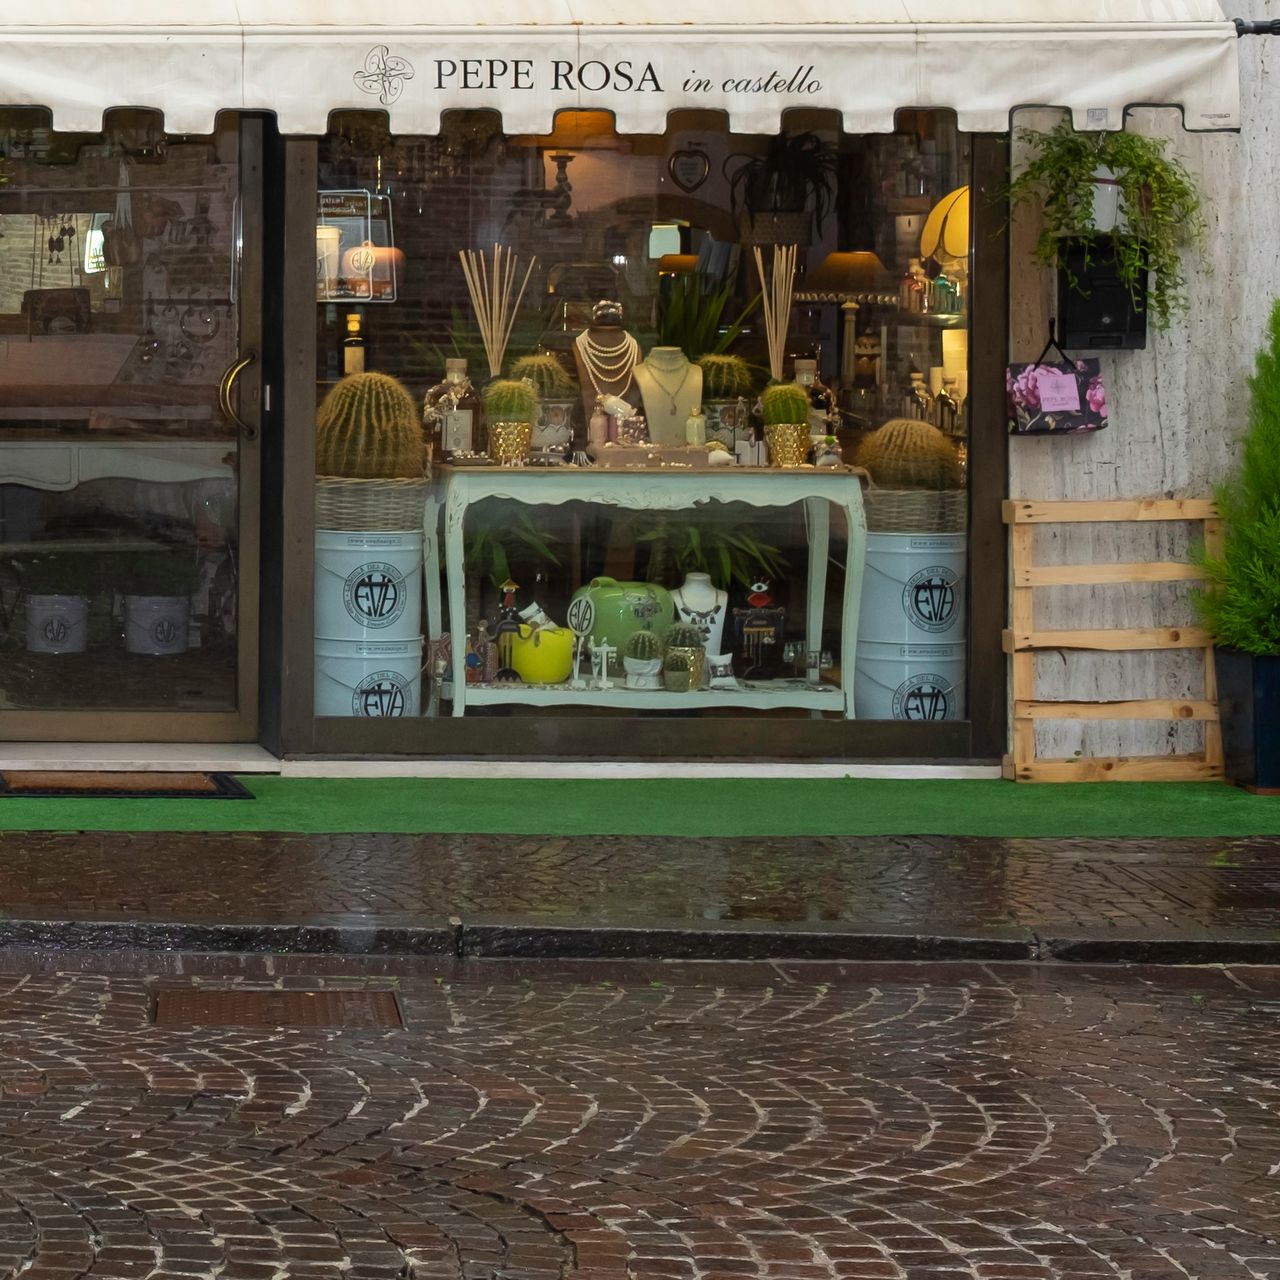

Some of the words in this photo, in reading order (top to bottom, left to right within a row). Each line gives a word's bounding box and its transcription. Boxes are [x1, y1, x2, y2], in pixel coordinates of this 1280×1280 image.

[433, 59, 534, 90] PEPE
[550, 60, 665, 92] ROSA
[682, 69, 714, 93] in
[721, 65, 824, 94] castello
